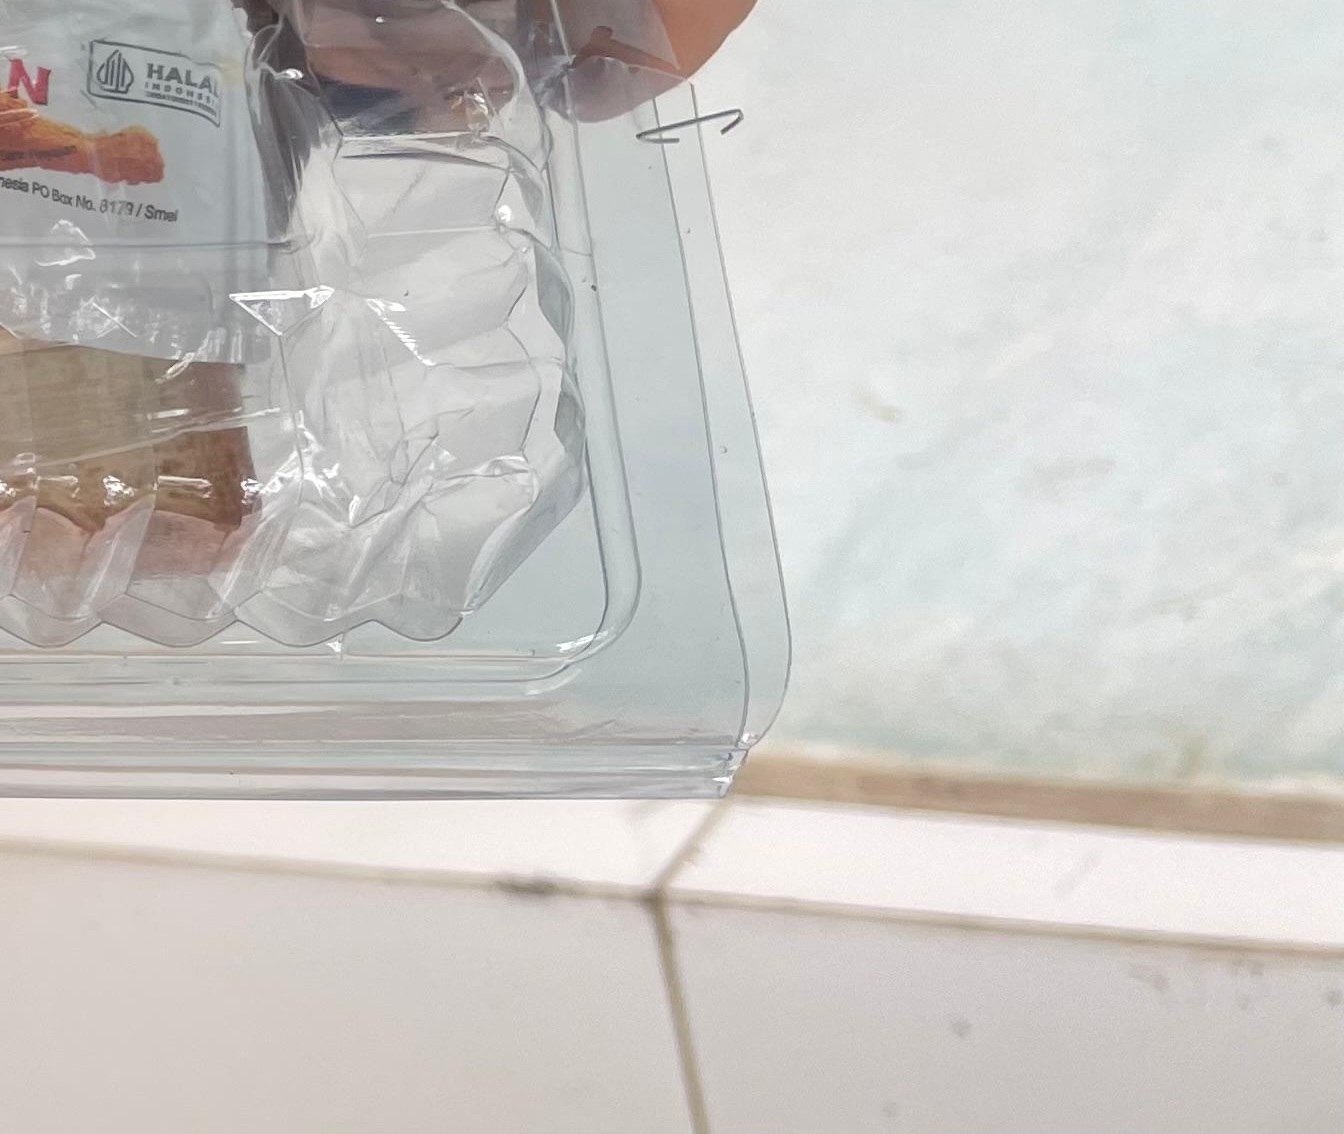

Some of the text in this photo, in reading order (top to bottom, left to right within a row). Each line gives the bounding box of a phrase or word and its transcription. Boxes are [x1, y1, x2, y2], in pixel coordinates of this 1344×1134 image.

[32, 181, 50, 199] PO
[52, 188, 73, 207] Box
[75, 194, 96, 212] No.
